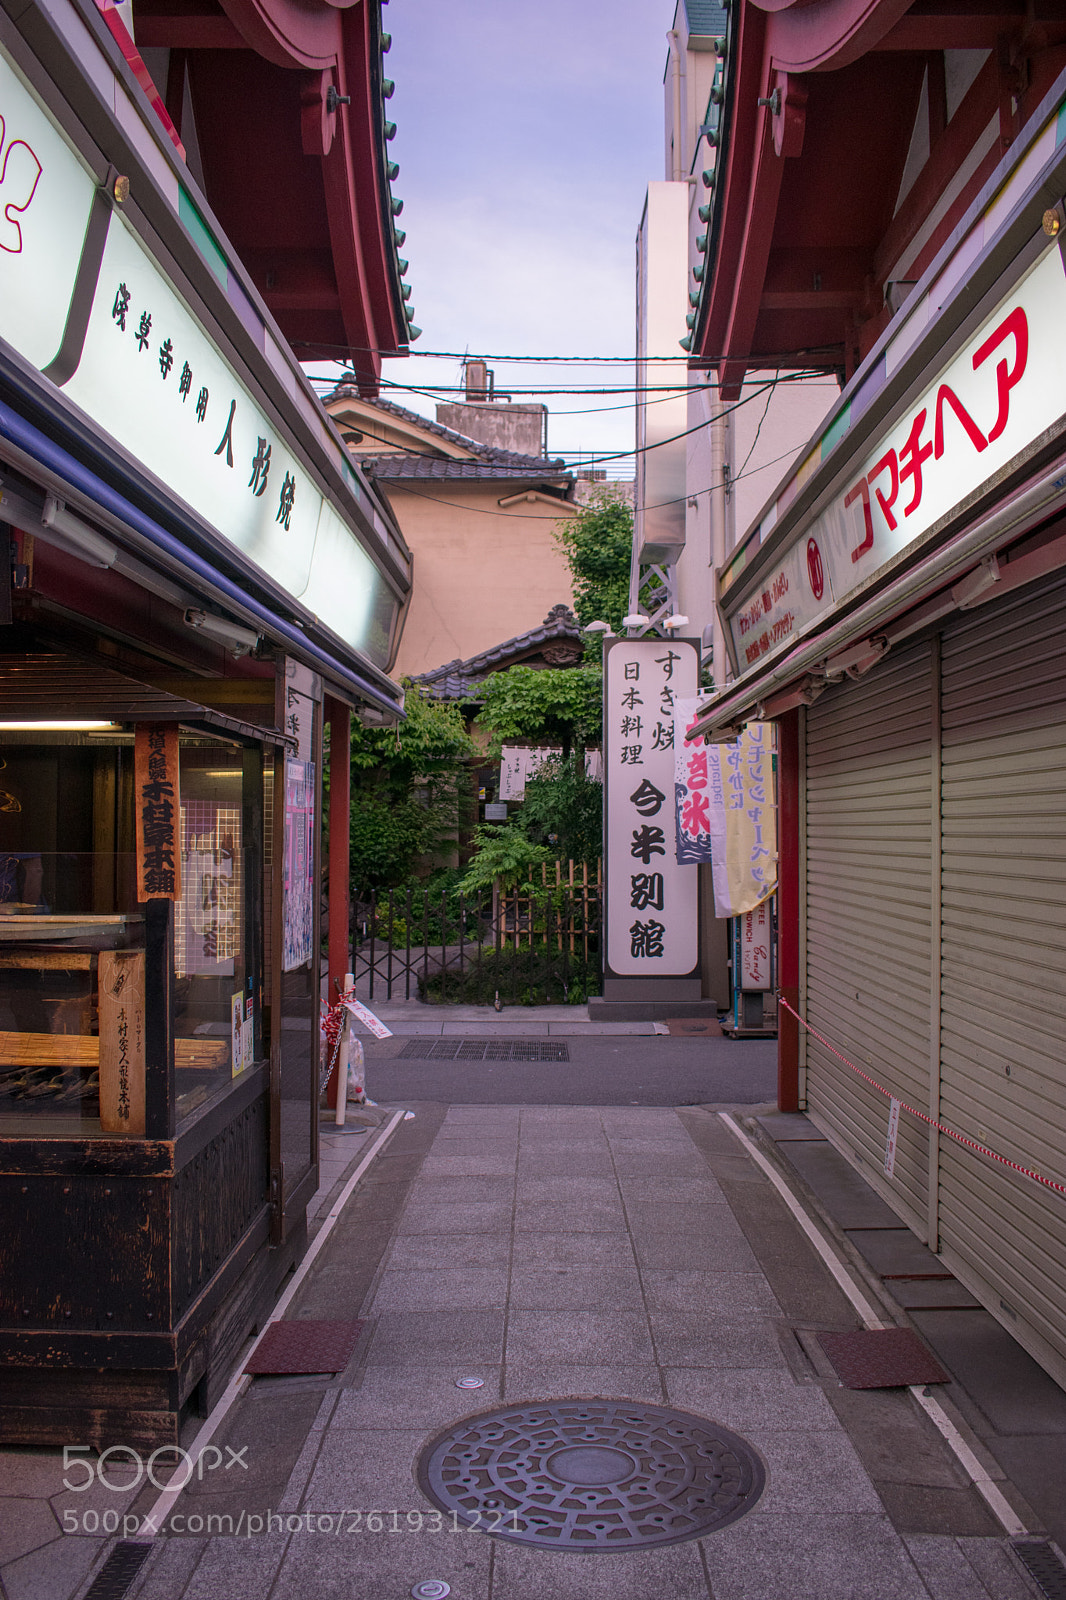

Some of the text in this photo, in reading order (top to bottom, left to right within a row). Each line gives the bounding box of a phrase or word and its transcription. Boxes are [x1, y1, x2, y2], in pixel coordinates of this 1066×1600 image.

[844, 306, 1029, 564] コマチヘア
[621, 661, 644, 765] 日本料理
[630, 778, 666, 958] 今半別館
[745, 911, 753, 943] NDWICH
[749, 945, 768, 982] Candy
